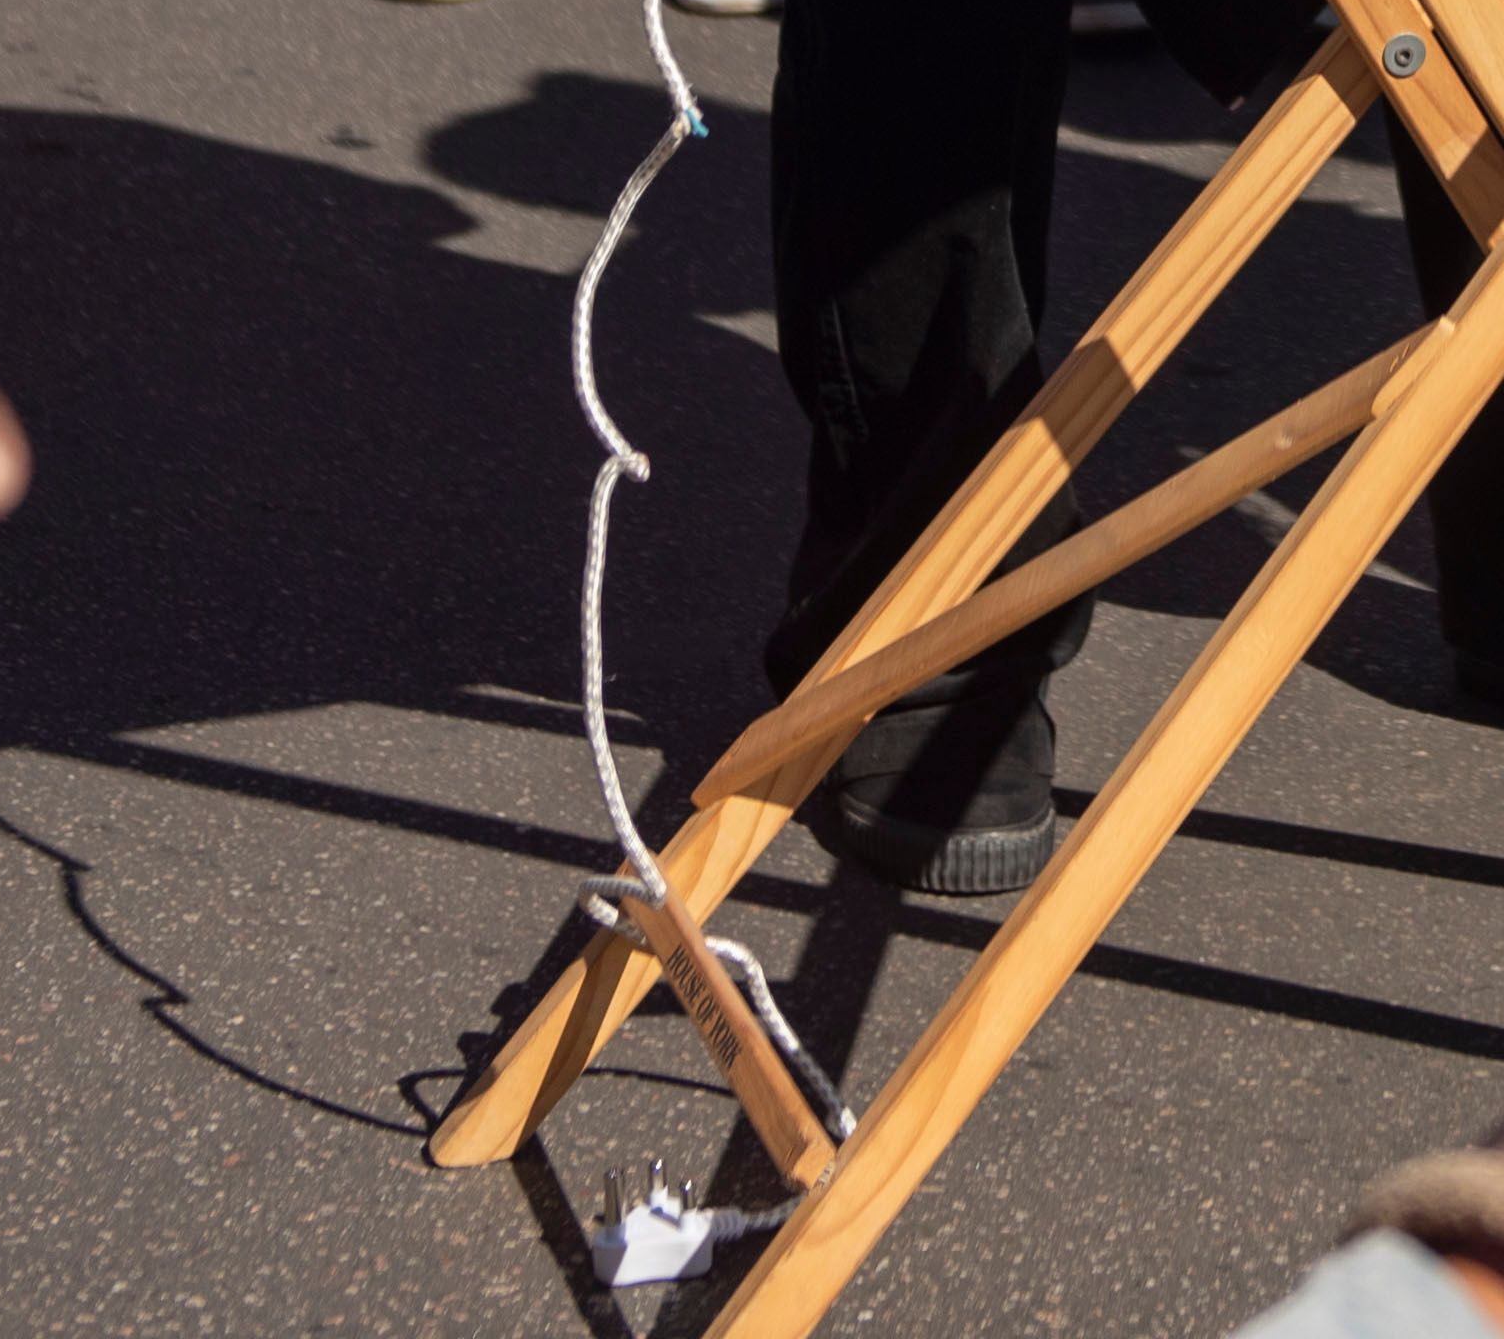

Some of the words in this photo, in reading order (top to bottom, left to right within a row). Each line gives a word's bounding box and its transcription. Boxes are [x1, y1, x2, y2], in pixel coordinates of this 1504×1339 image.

[667, 943, 705, 1003] HOUSE
[696, 994, 720, 1025] OF
[708, 1008, 743, 1069] YORK
